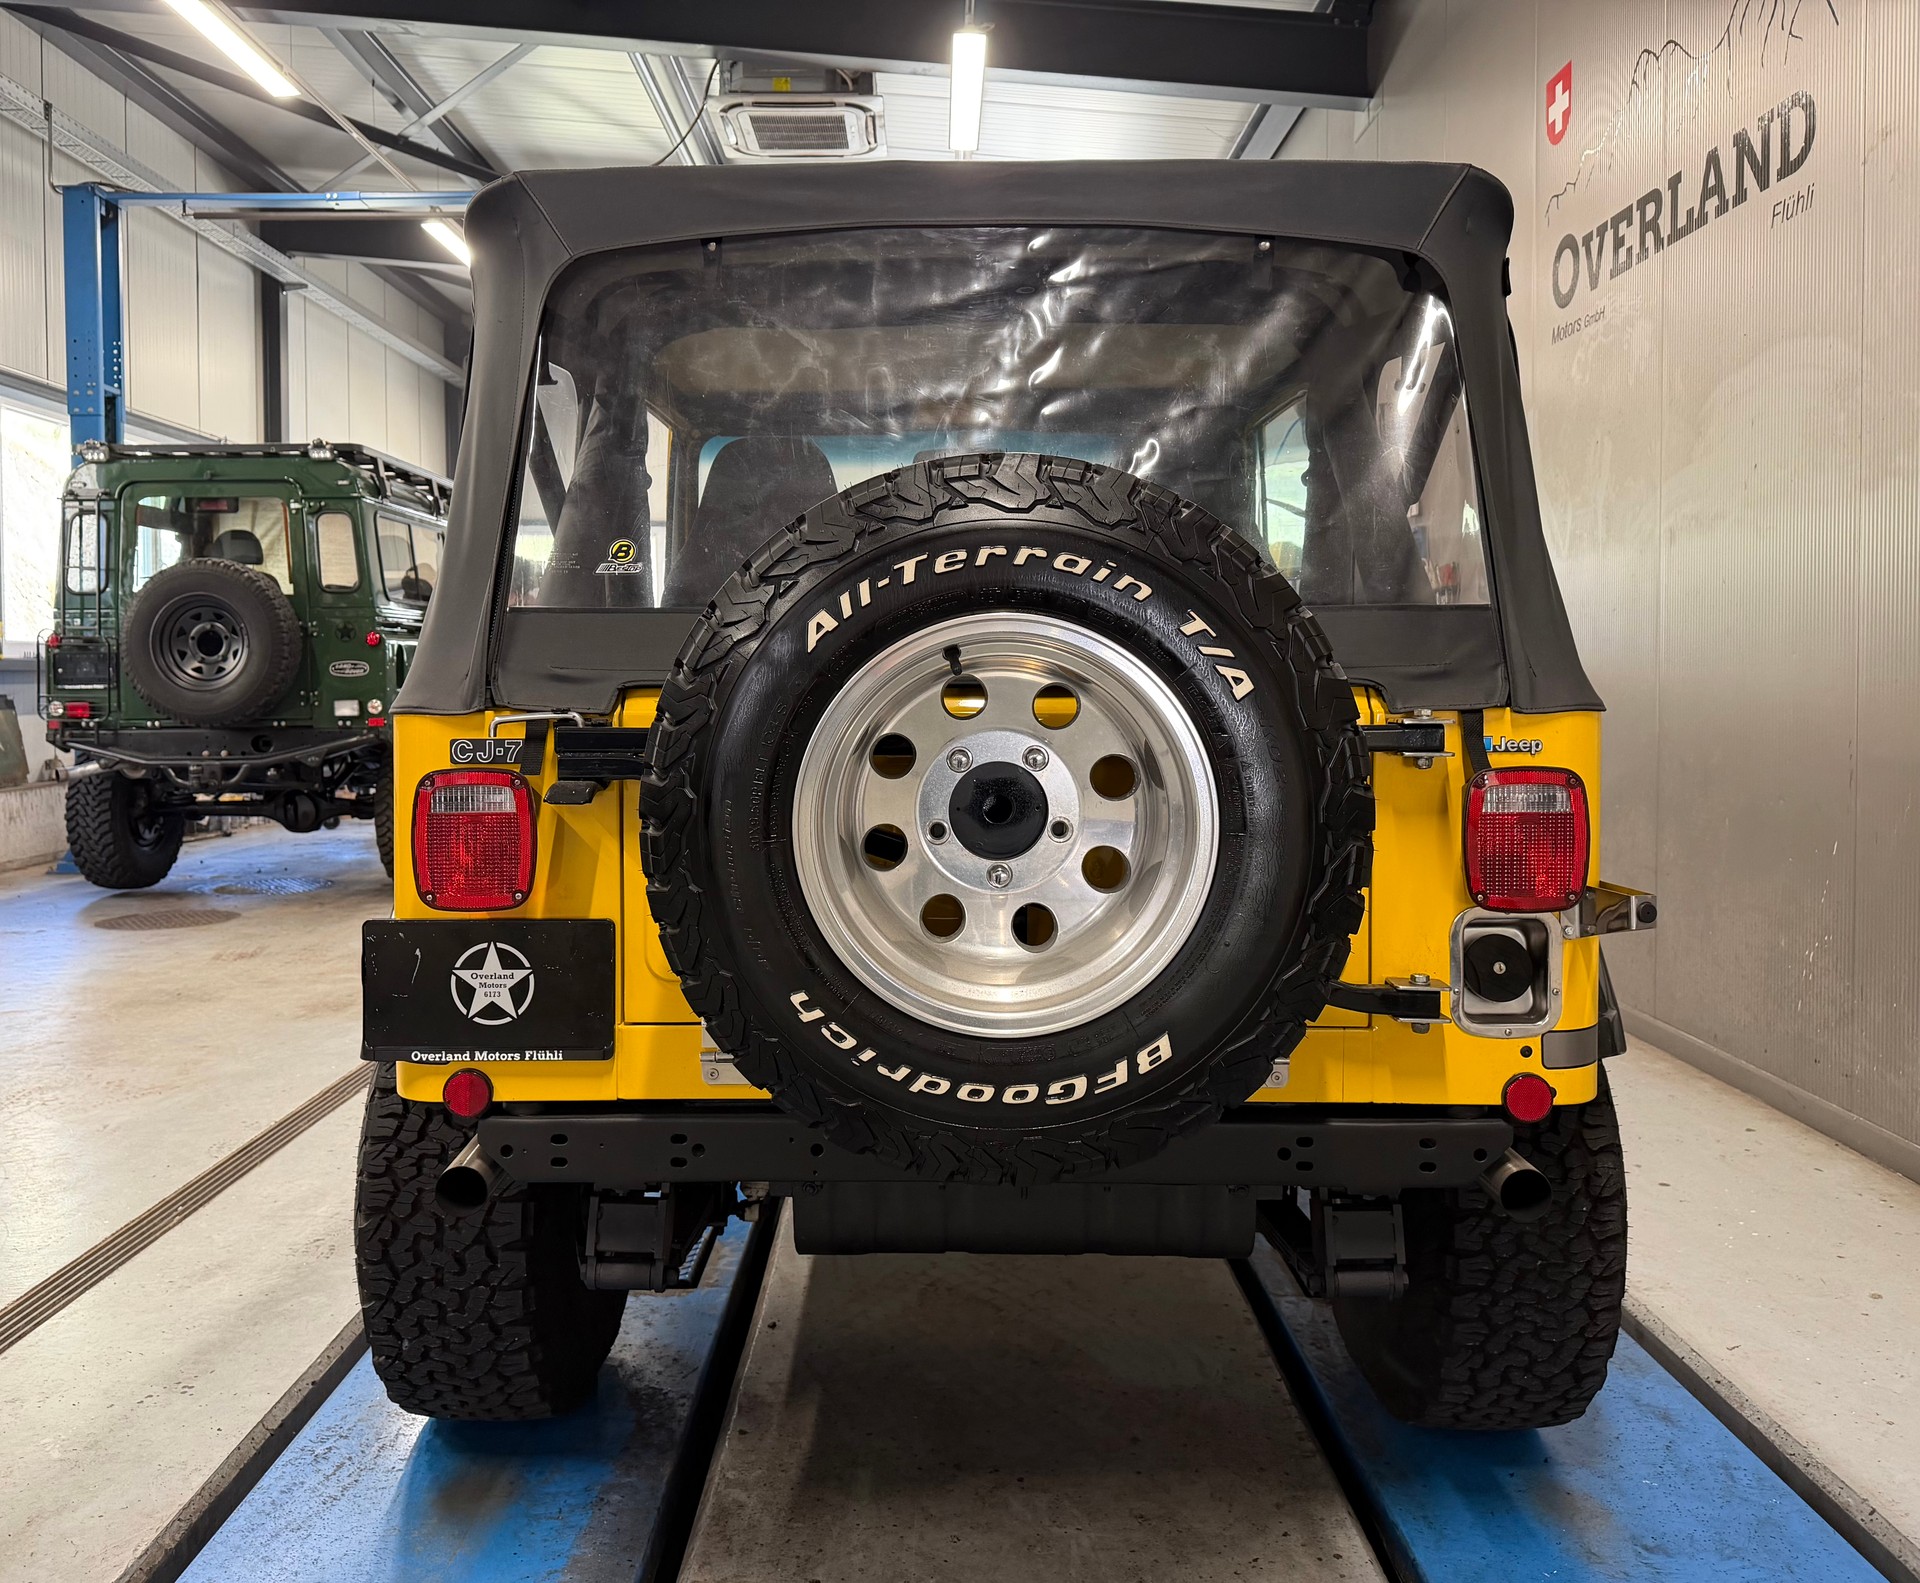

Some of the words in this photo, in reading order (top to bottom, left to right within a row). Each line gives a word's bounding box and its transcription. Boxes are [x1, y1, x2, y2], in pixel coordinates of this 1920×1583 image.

[1552, 90, 1817, 309] OVERLAND
[1770, 182, 1815, 229] Flühli
[1551, 317, 1582, 345] Motors
[1583, 304, 1606, 328] GmbH
[805, 544, 1152, 654] All-Terrain
[1178, 610, 1256, 702] T/A
[451, 739, 523, 763] CJ-7
[1495, 736, 1543, 755] Jeep
[470, 972, 515, 980] Overland
[411, 1050, 470, 1061] Overland
[474, 1050, 520, 1061] Motors
[524, 1050, 563, 1061] Flühli
[789, 990, 1173, 1106] BFGoodrich
